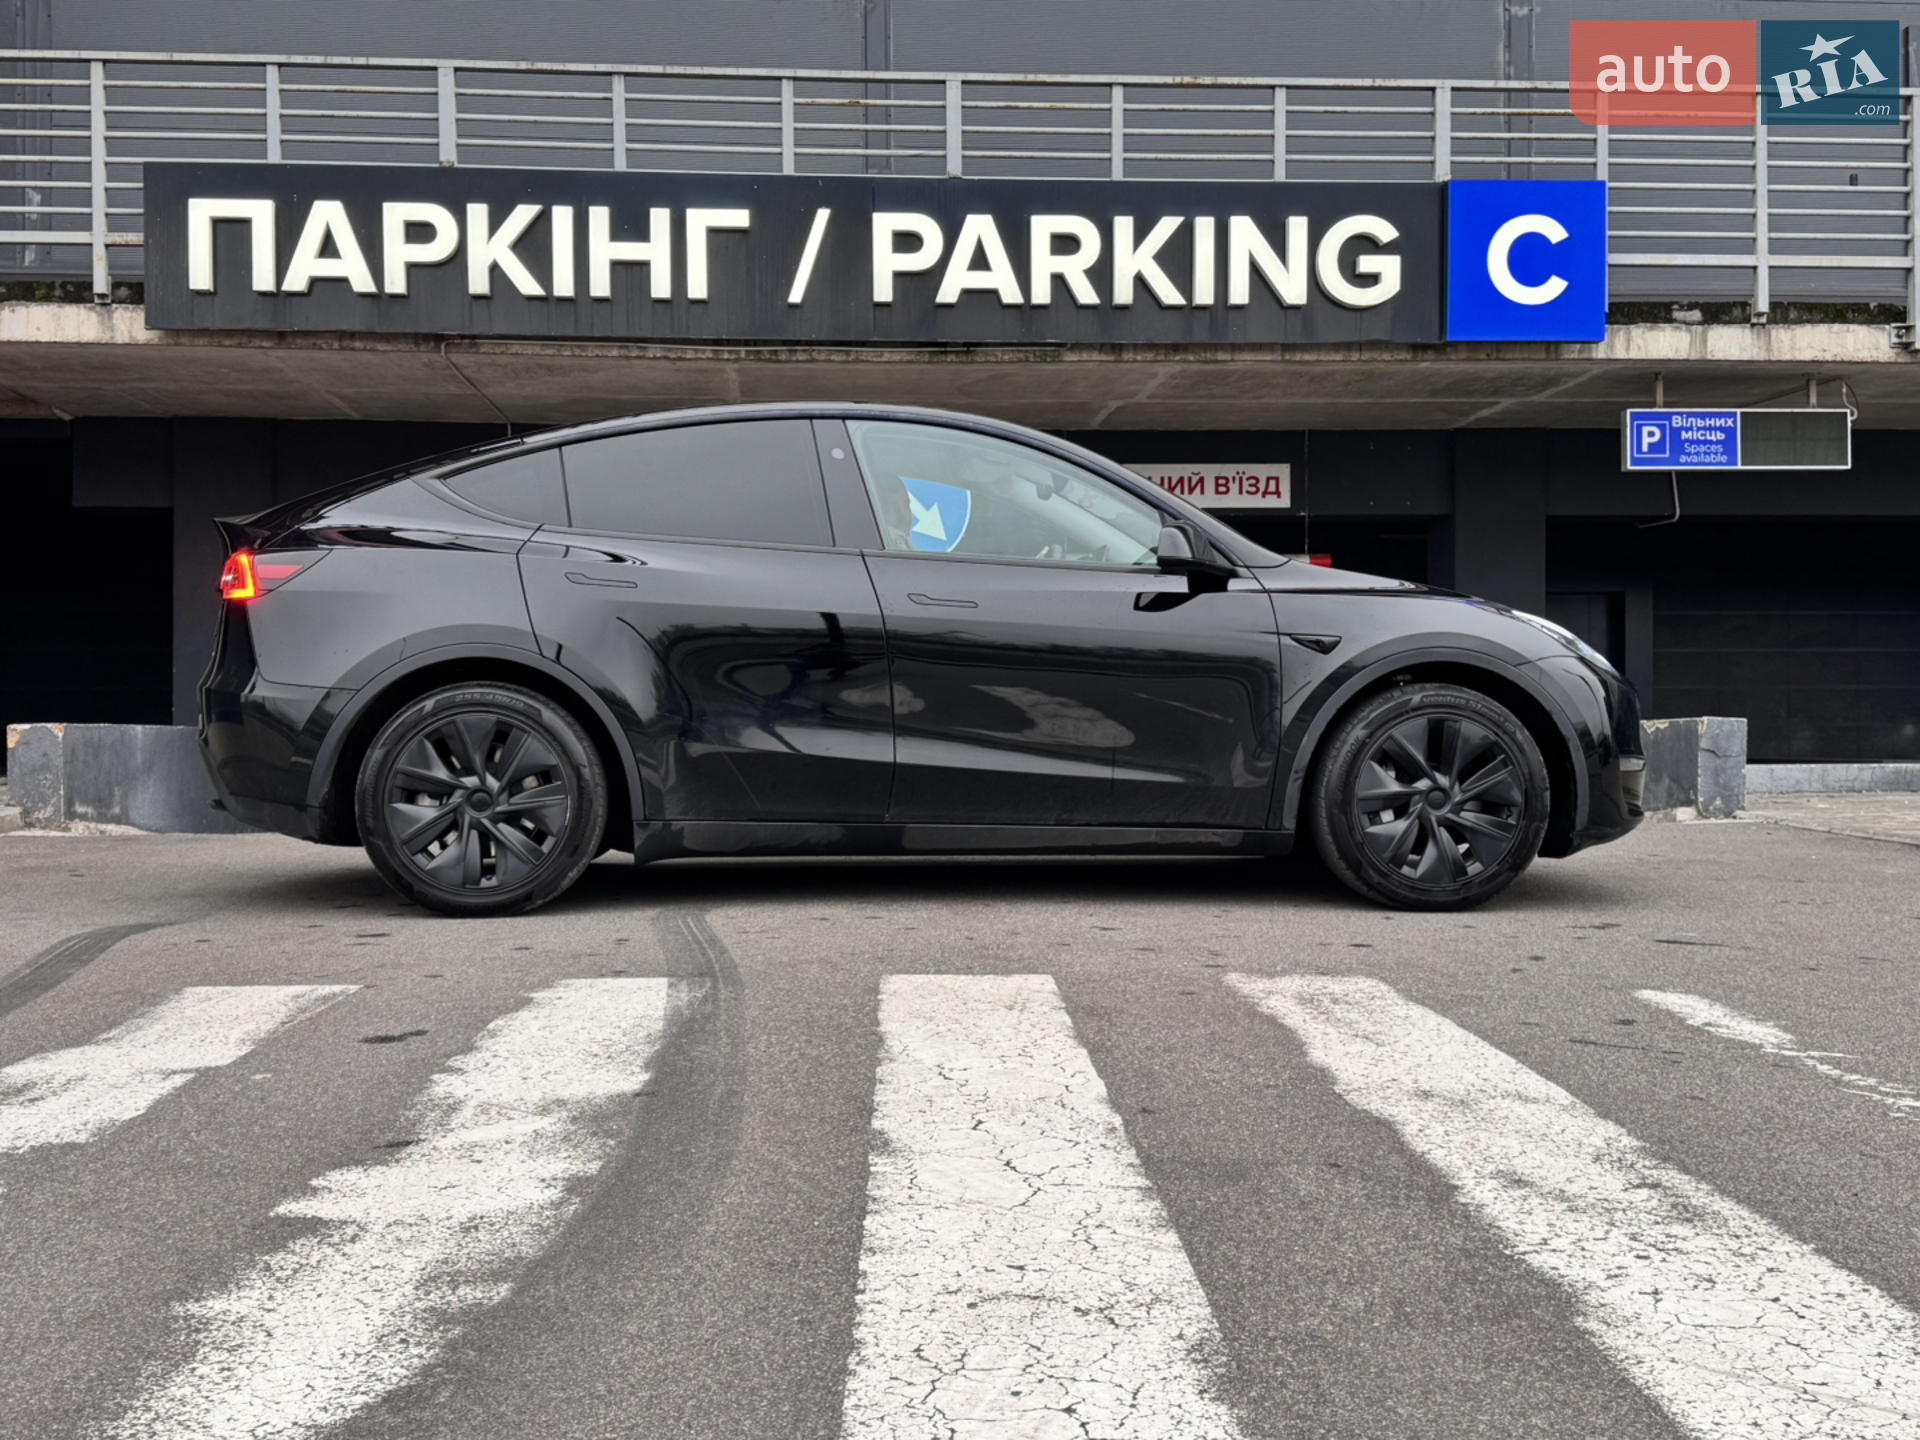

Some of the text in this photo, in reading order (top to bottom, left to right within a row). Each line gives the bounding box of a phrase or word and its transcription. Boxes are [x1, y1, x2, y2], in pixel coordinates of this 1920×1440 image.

[187, 198, 1402, 310] ПАРКІНГ / PARKING
[1486, 213, 1570, 306] C
[1672, 414, 1734, 428] Вільних
[1641, 426, 1661, 453] P
[1681, 427, 1726, 442] місць
[1679, 453, 1728, 464] available
[1684, 442, 1724, 454] Spaces
[1214, 471, 1281, 499] В'ЇЗД
